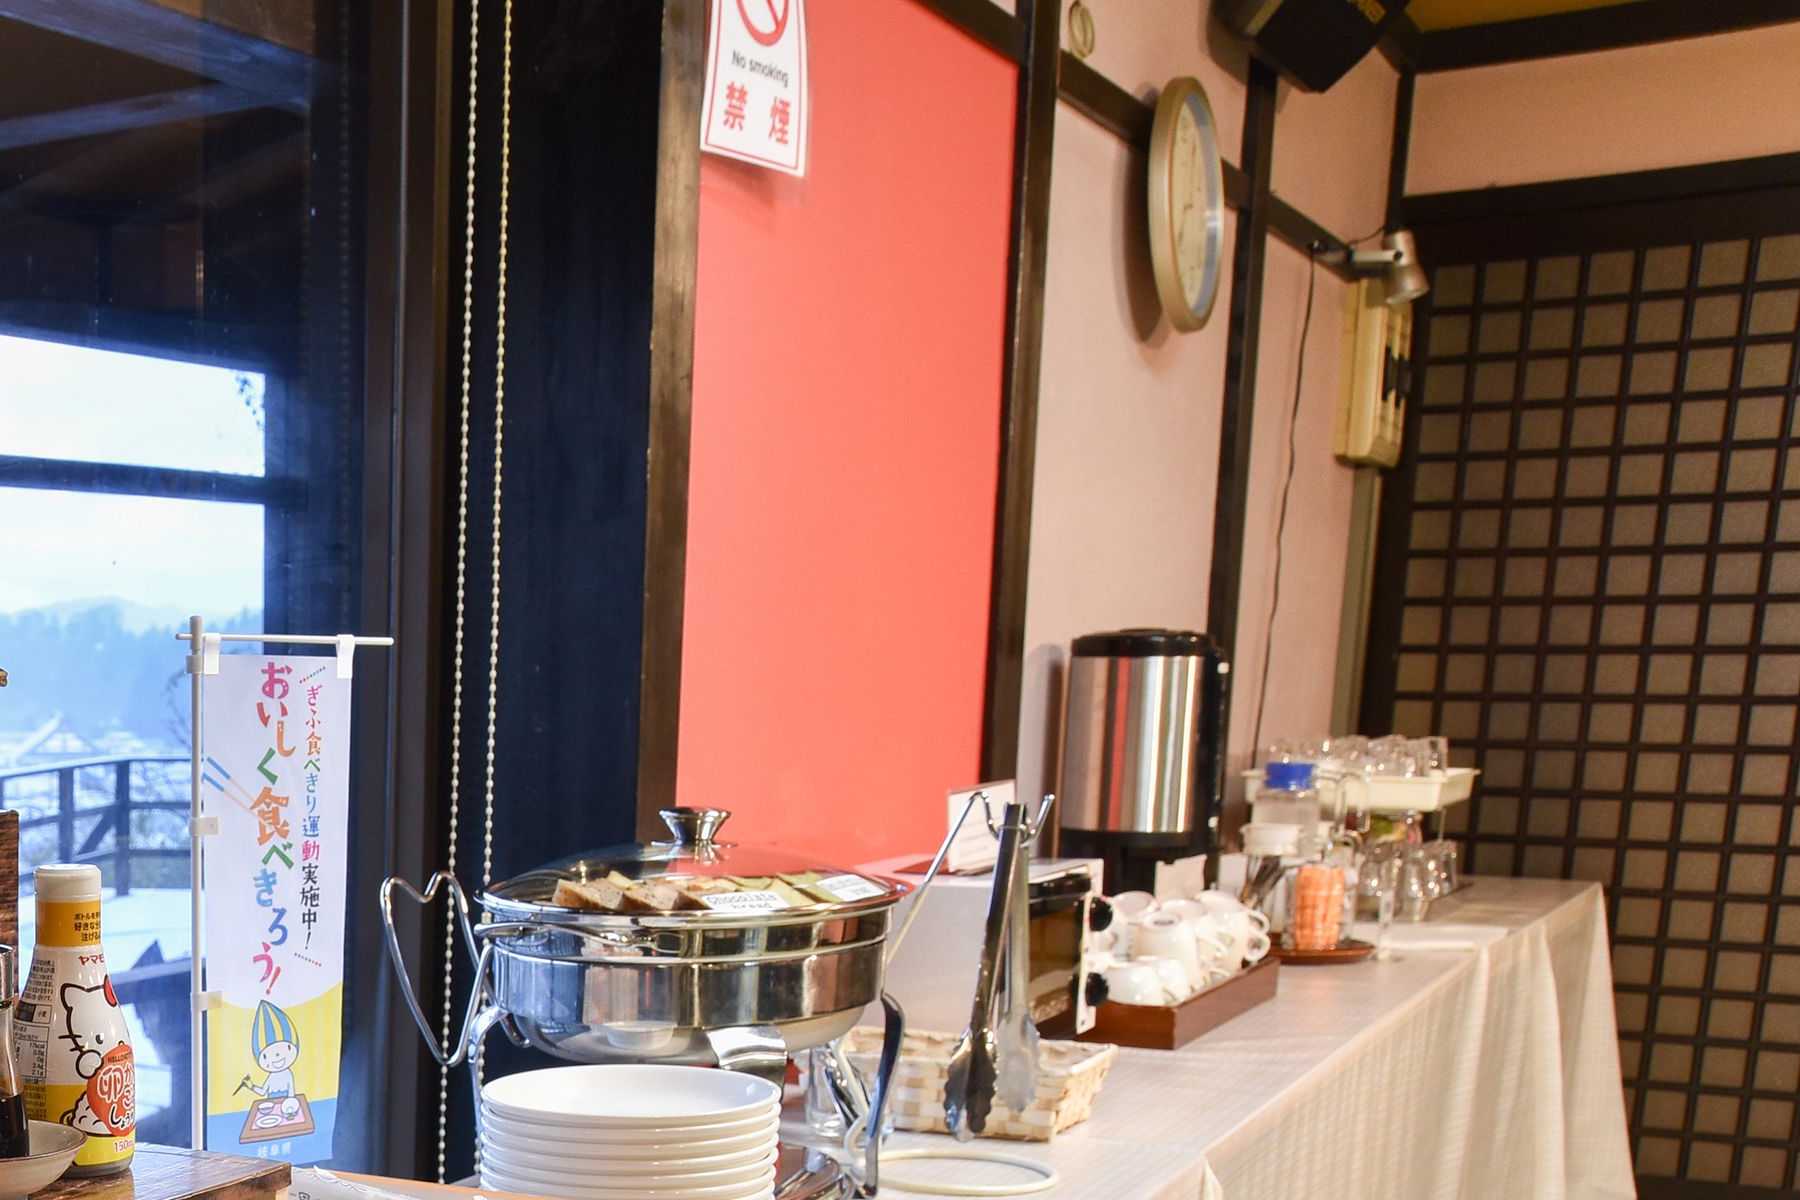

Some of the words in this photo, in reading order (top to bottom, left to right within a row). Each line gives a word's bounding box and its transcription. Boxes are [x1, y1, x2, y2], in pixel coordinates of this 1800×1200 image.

[731, 50, 747, 69] No
[749, 58, 790, 88] smoking
[723, 81, 791, 145] 禁煙
